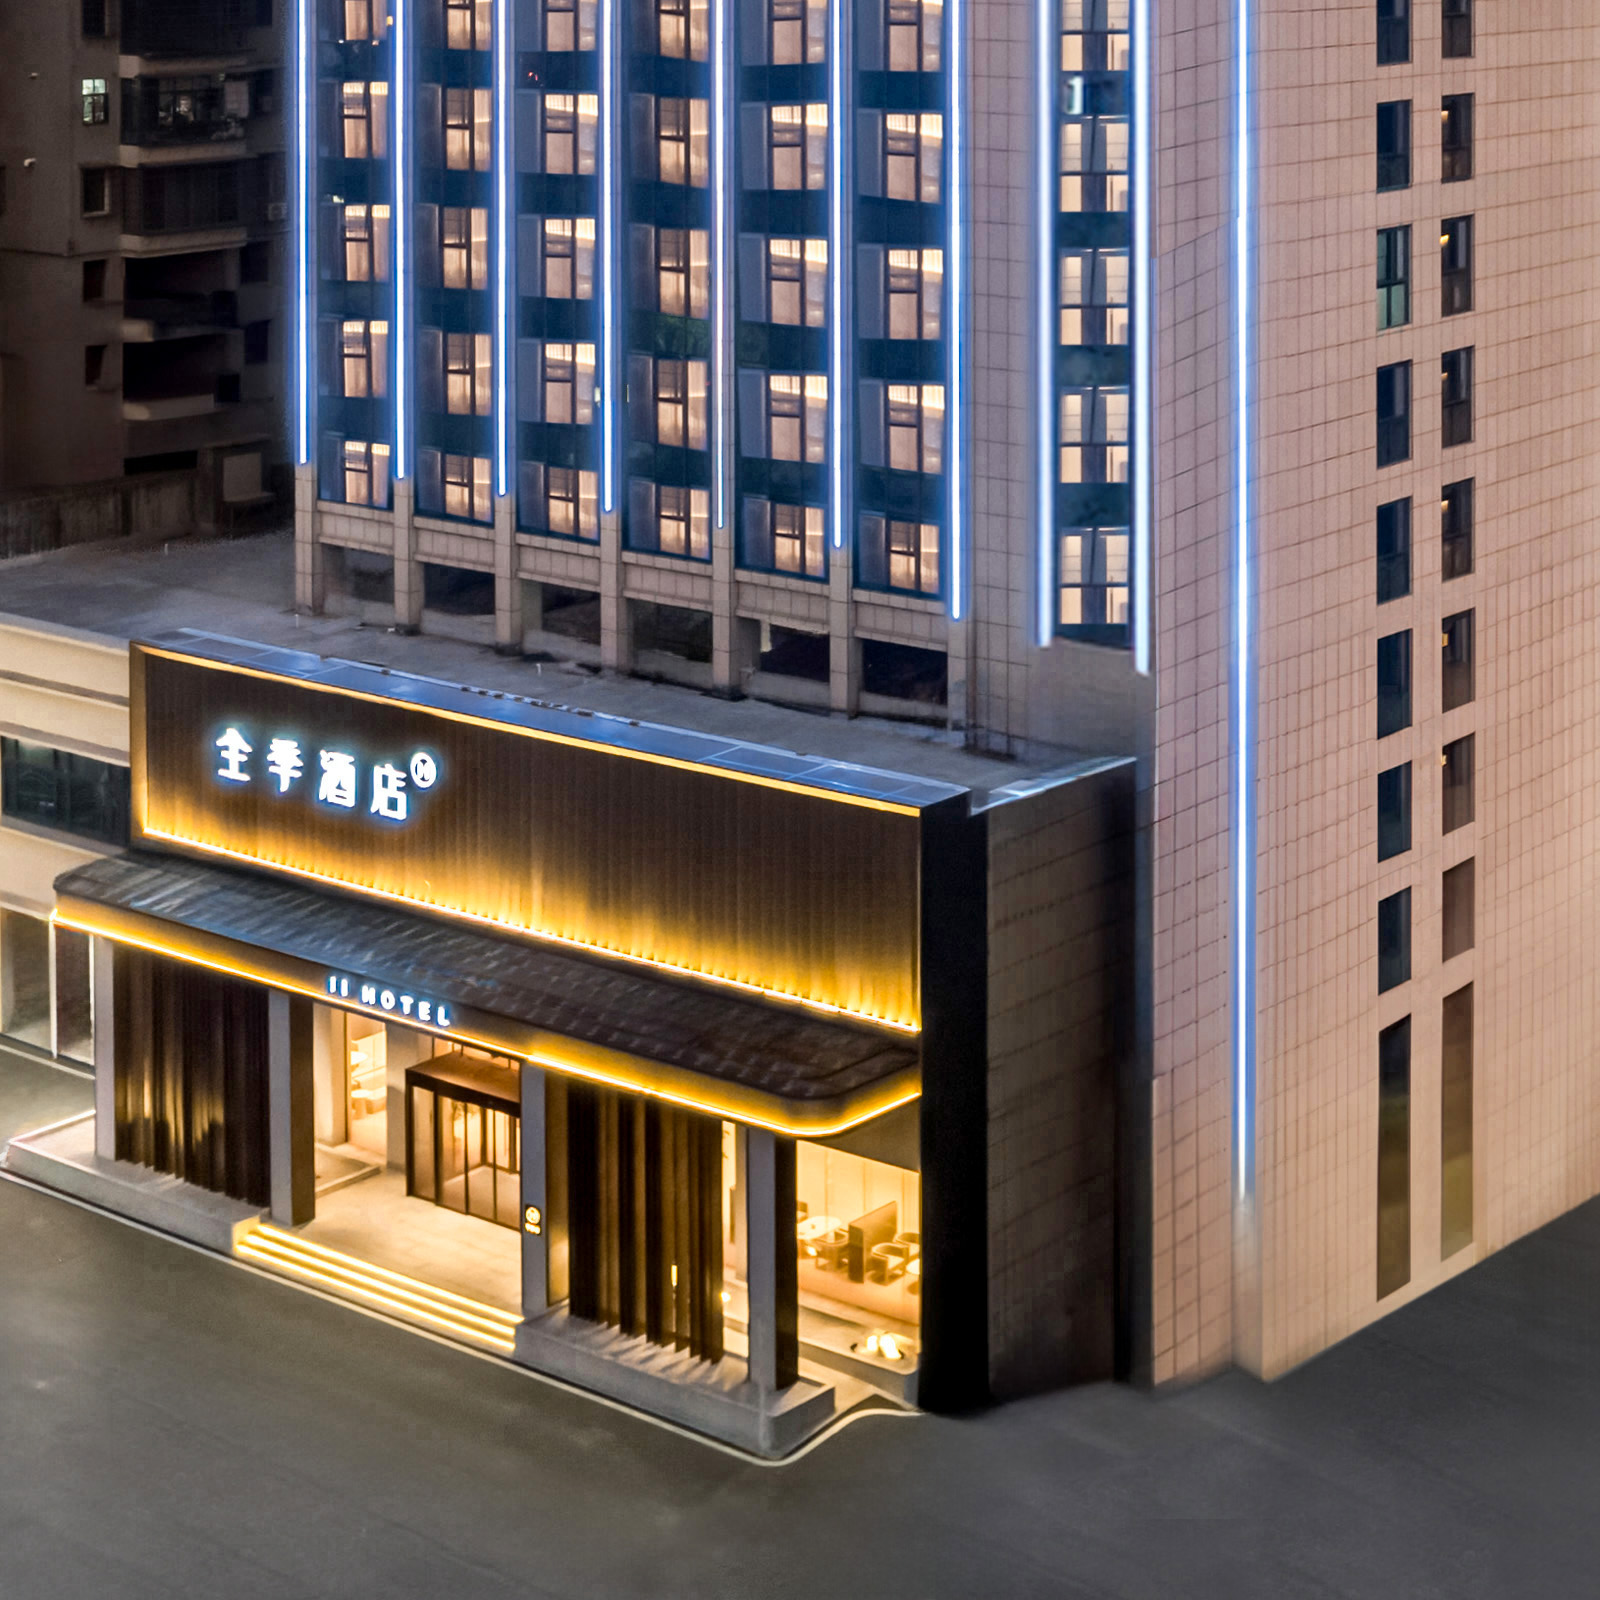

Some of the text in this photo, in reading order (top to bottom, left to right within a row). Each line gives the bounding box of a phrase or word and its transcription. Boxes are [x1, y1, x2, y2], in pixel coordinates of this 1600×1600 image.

[215, 727, 408, 821] 全季酒店
[361, 984, 451, 1027] HOTEL
